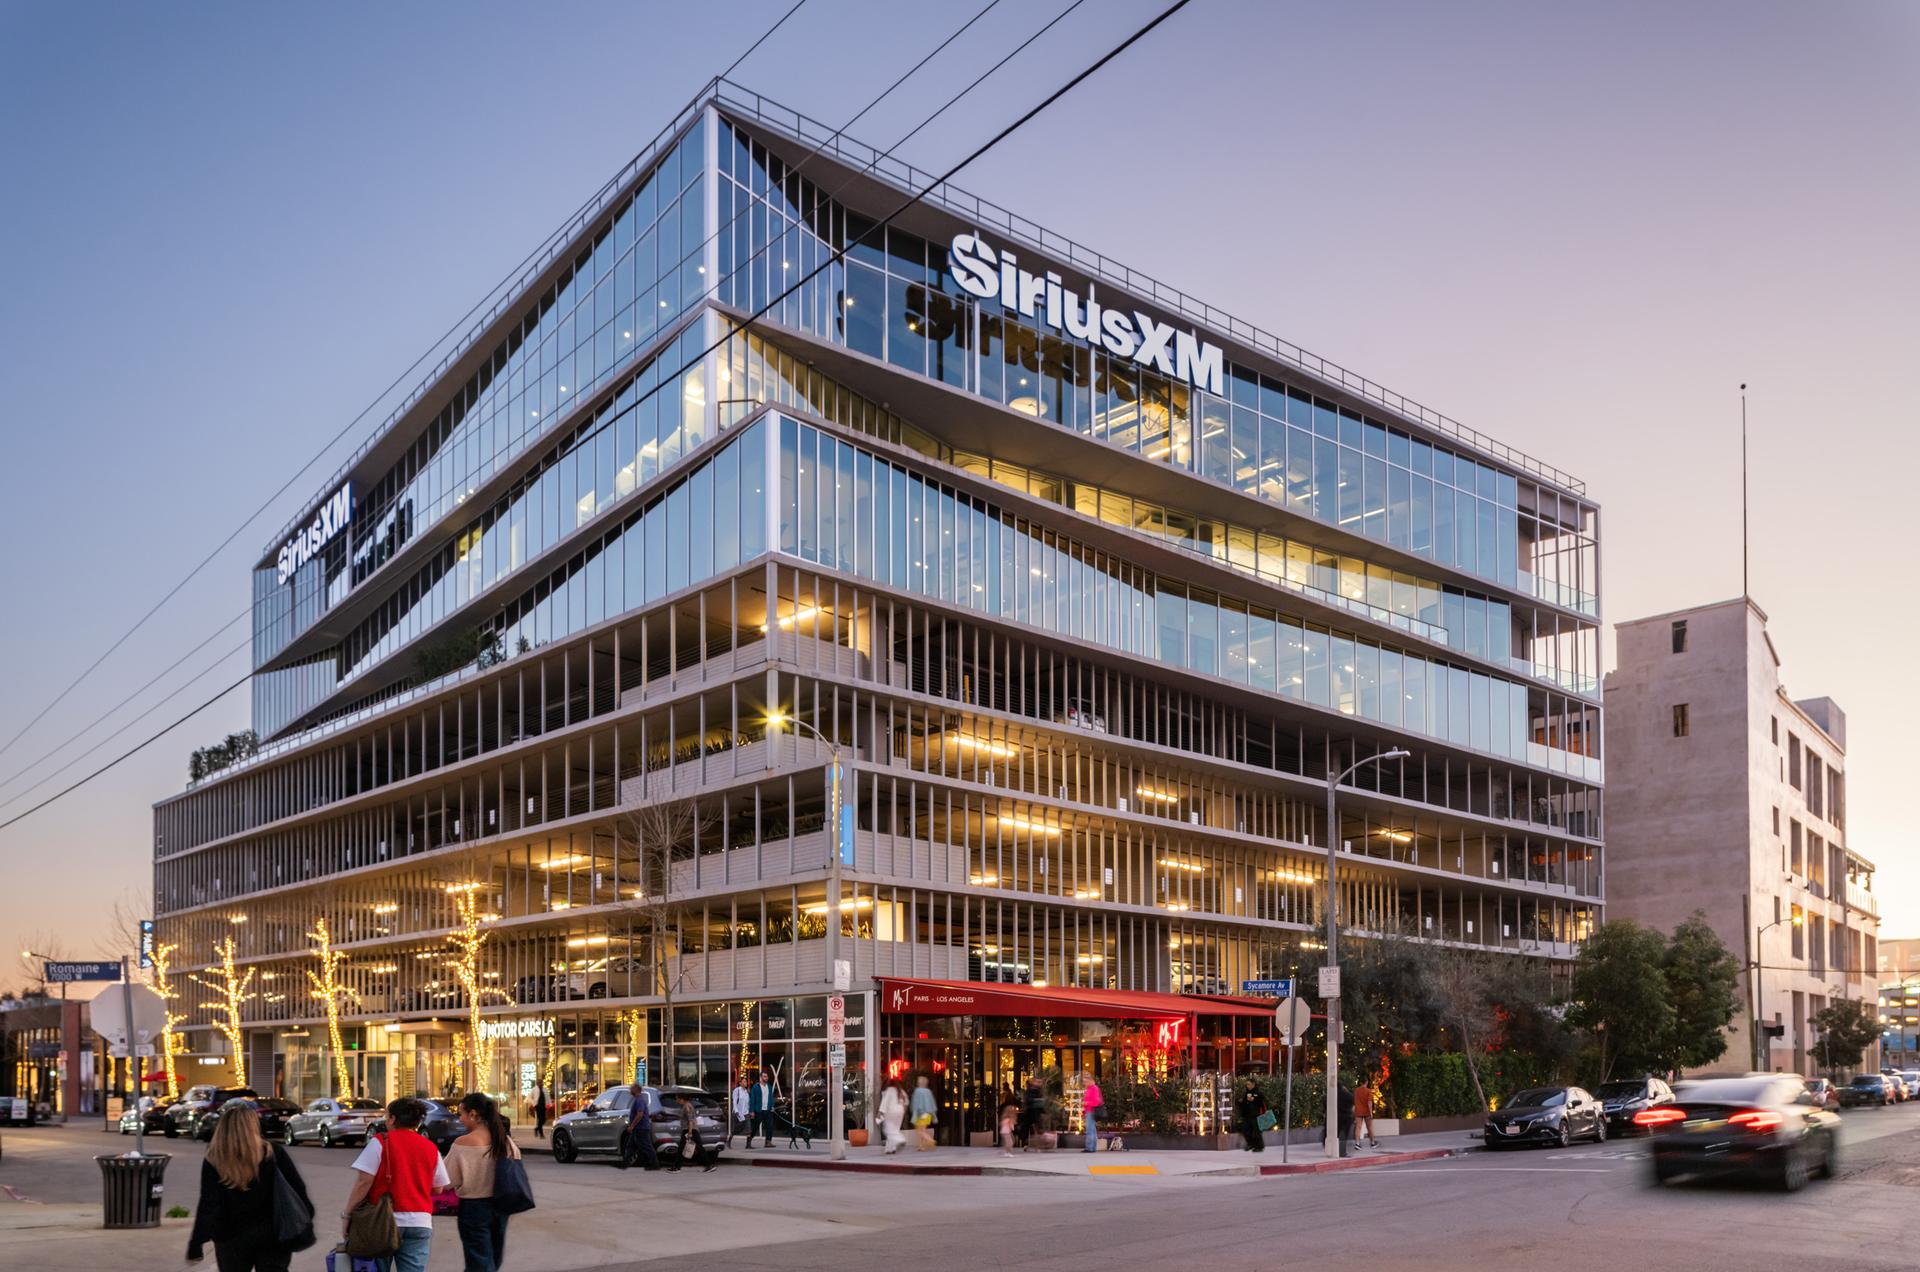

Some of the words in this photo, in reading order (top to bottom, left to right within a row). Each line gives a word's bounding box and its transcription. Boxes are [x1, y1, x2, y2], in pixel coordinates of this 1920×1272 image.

[950, 233, 1223, 396] SiriusXM
[278, 482, 351, 585] SiriusXM
[49, 963, 100, 974] Romaine
[50, 973, 72, 981] 7000
[1247, 982, 1275, 990] Sycamore
[799, 1018, 823, 1027] PASTRIES
[487, 1022, 517, 1038] MOTOR
[517, 1021, 541, 1038] CARS
[542, 1020, 555, 1037] LA
